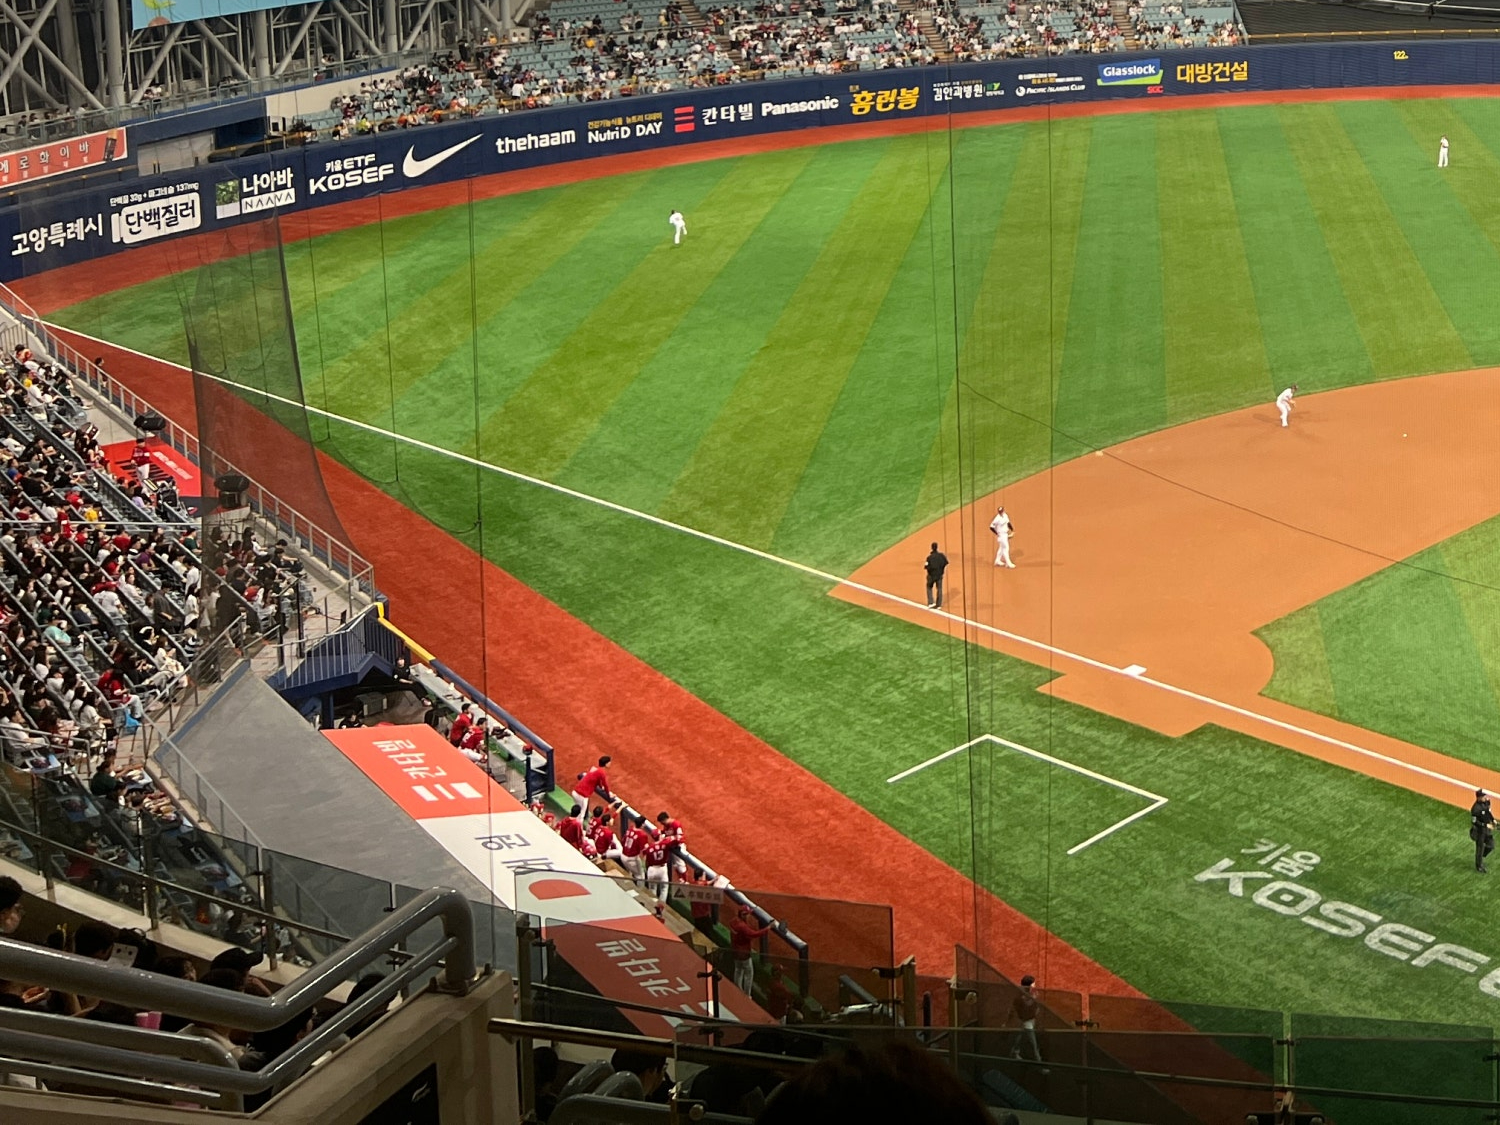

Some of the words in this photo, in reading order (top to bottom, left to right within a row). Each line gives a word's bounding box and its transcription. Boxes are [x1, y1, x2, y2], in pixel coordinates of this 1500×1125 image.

[1102, 62, 1156, 77] Glasslock
[1177, 61, 1248, 83] 대방건설
[761, 95, 839, 118] Panasonic
[850, 86, 920, 116] 홈런볼
[933, 84, 984, 102] 김안과병원
[702, 103, 754, 126] 칸타빌
[495, 129, 576, 155] thehaam
[636, 121, 663, 136] DAY
[242, 167, 294, 195] 나아바
[309, 163, 395, 196] KOSEF
[125, 199, 196, 235] 단백질러
[11, 213, 103, 256] 고양특례시
[1241, 838, 1322, 877] 키움
[1194, 858, 1492, 974] KOSEF
